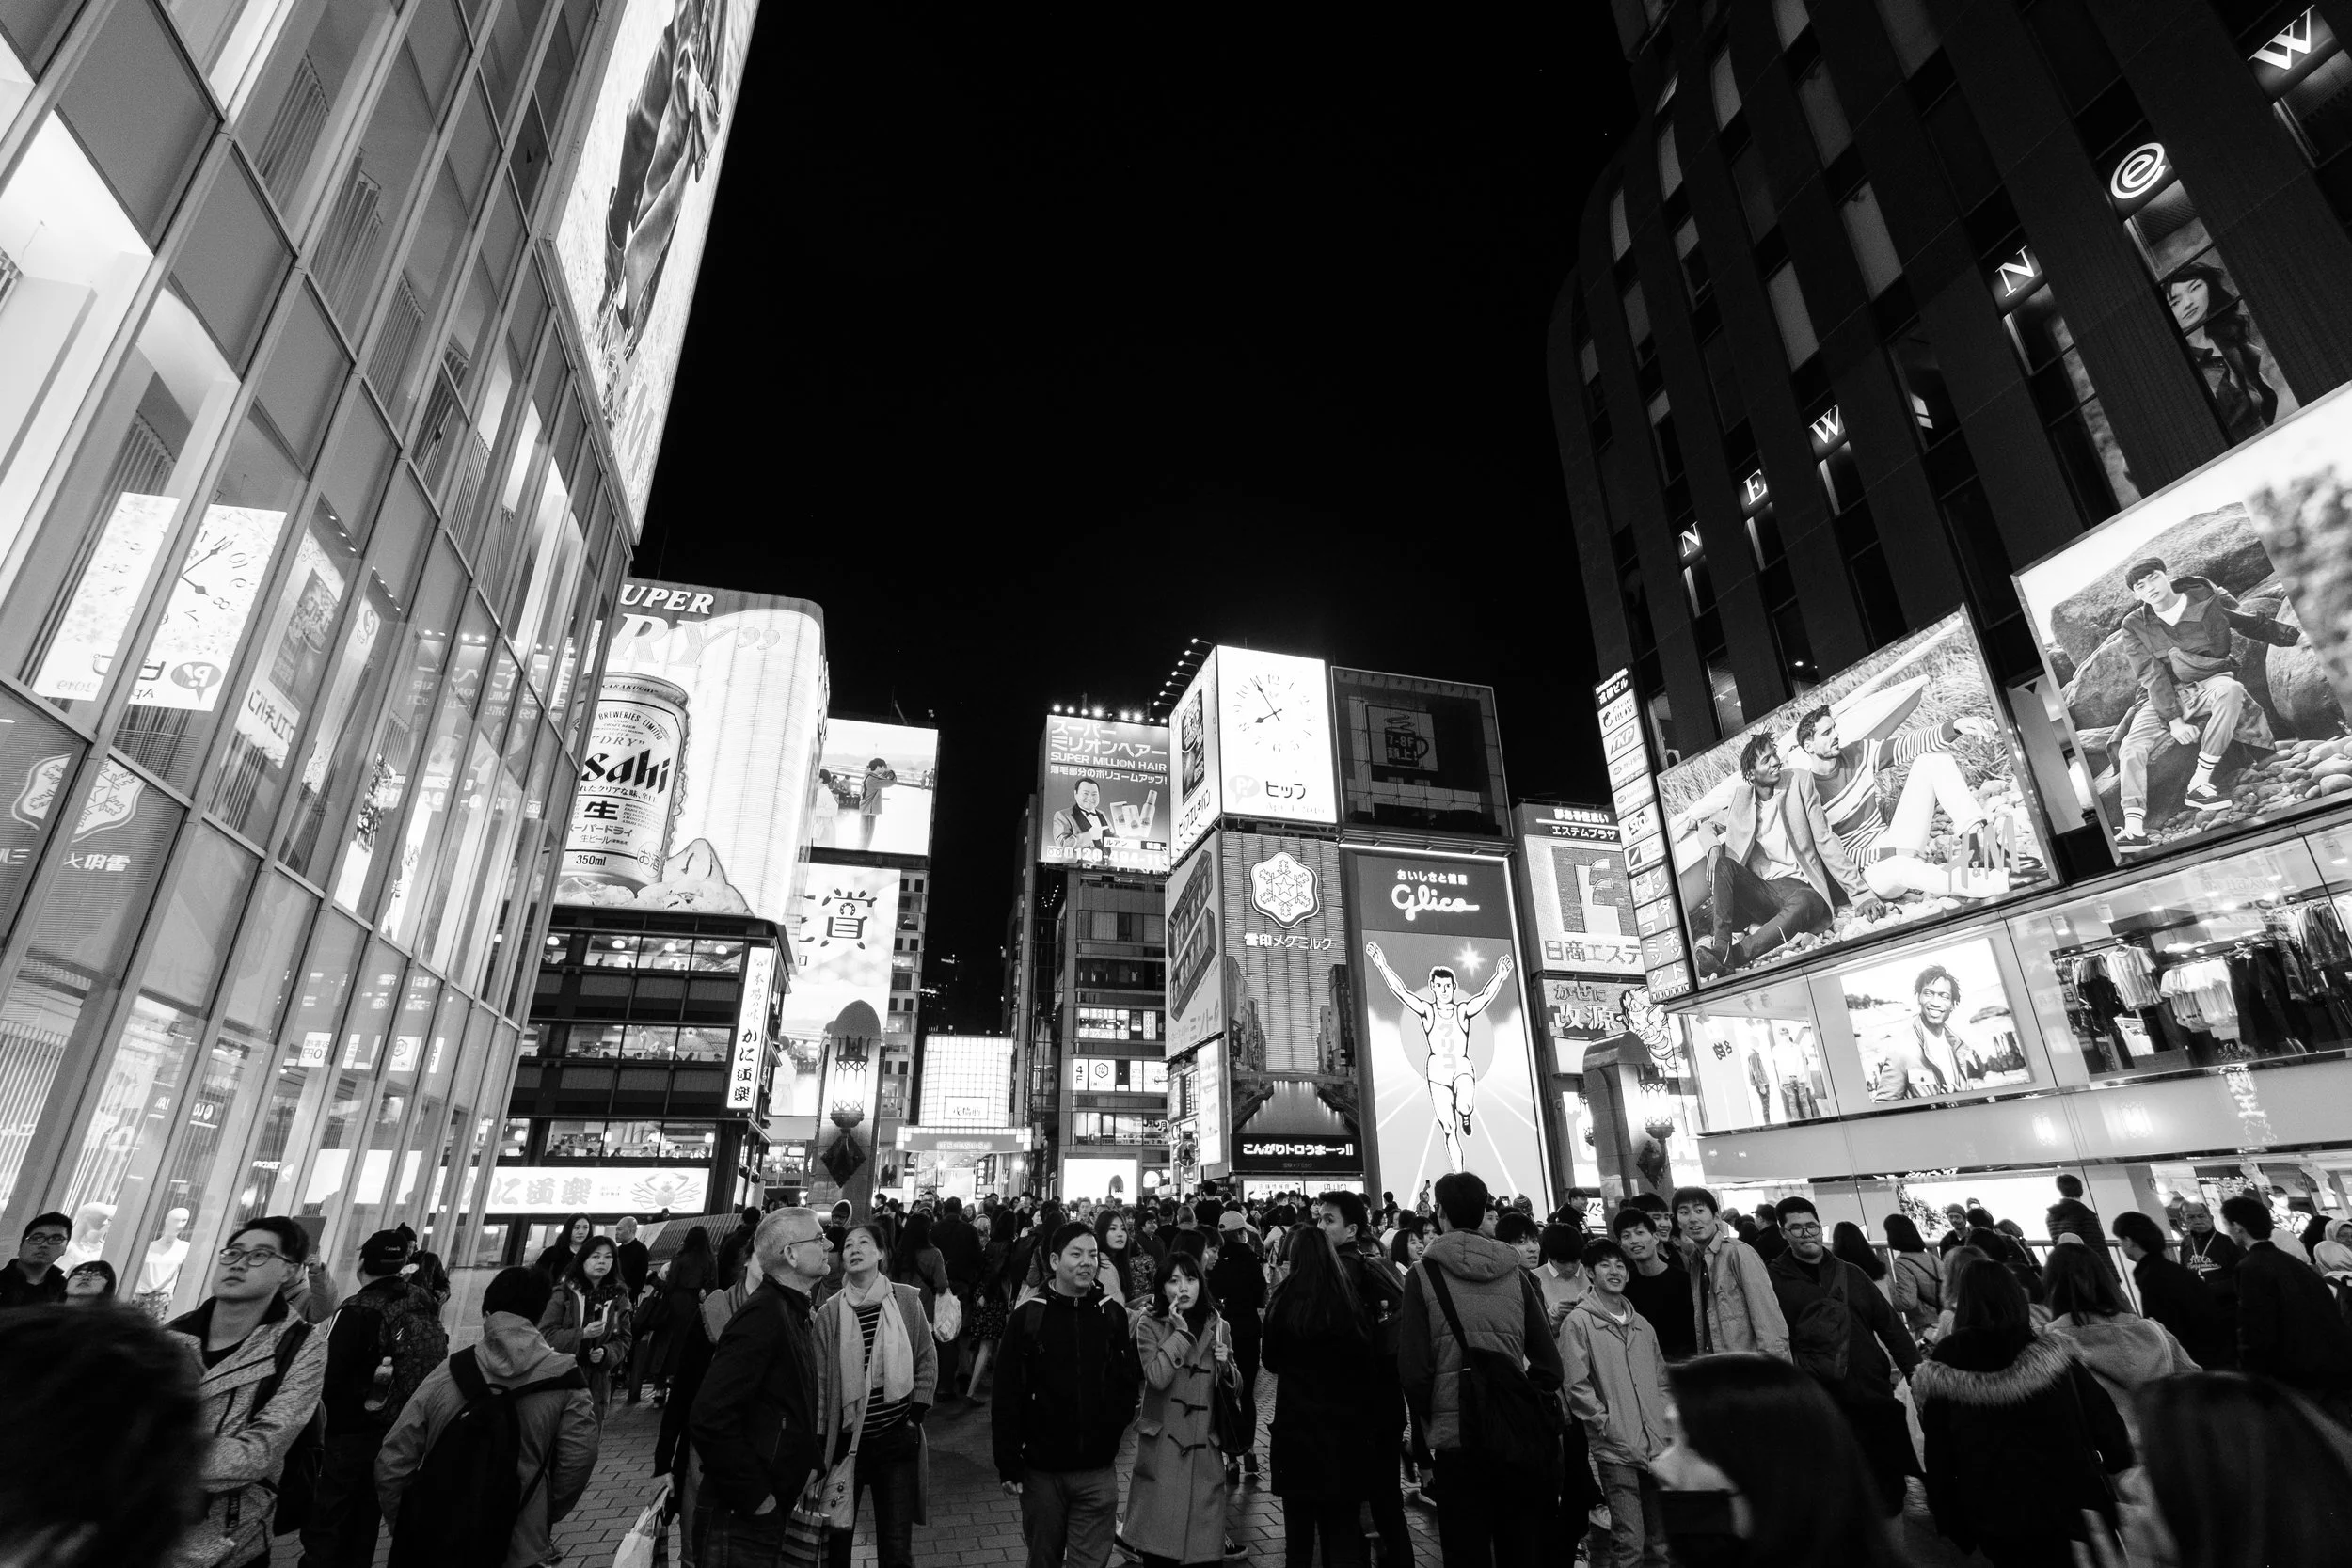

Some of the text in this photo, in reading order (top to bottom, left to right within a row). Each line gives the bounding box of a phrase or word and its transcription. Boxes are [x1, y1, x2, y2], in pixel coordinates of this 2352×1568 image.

[619, 583, 715, 615] UPER
[598, 710, 663, 741] BREWERIES LIMITED
[1052, 718, 1117, 737] スーパー
[1051, 736, 1168, 758] ミリオンヘアー
[580, 749, 671, 794] sahi
[1050, 752, 1168, 772] SUPER MILLION HAIR
[583, 800, 620, 821] 生
[575, 854, 607, 866] 350ml
[1939, 815, 2021, 894] H&M
[1396, 868, 1468, 886] おいしさと健康
[1244, 931, 1332, 951] 雪印メグミルク
[1544, 940, 1642, 965] 日商エステ
[1553, 983, 1607, 1003] かぜに
[1552, 1003, 1618, 1031] 改源
[1437, 1021, 1458, 1069] グリコ
[491, 1176, 594, 1207] に道楽
